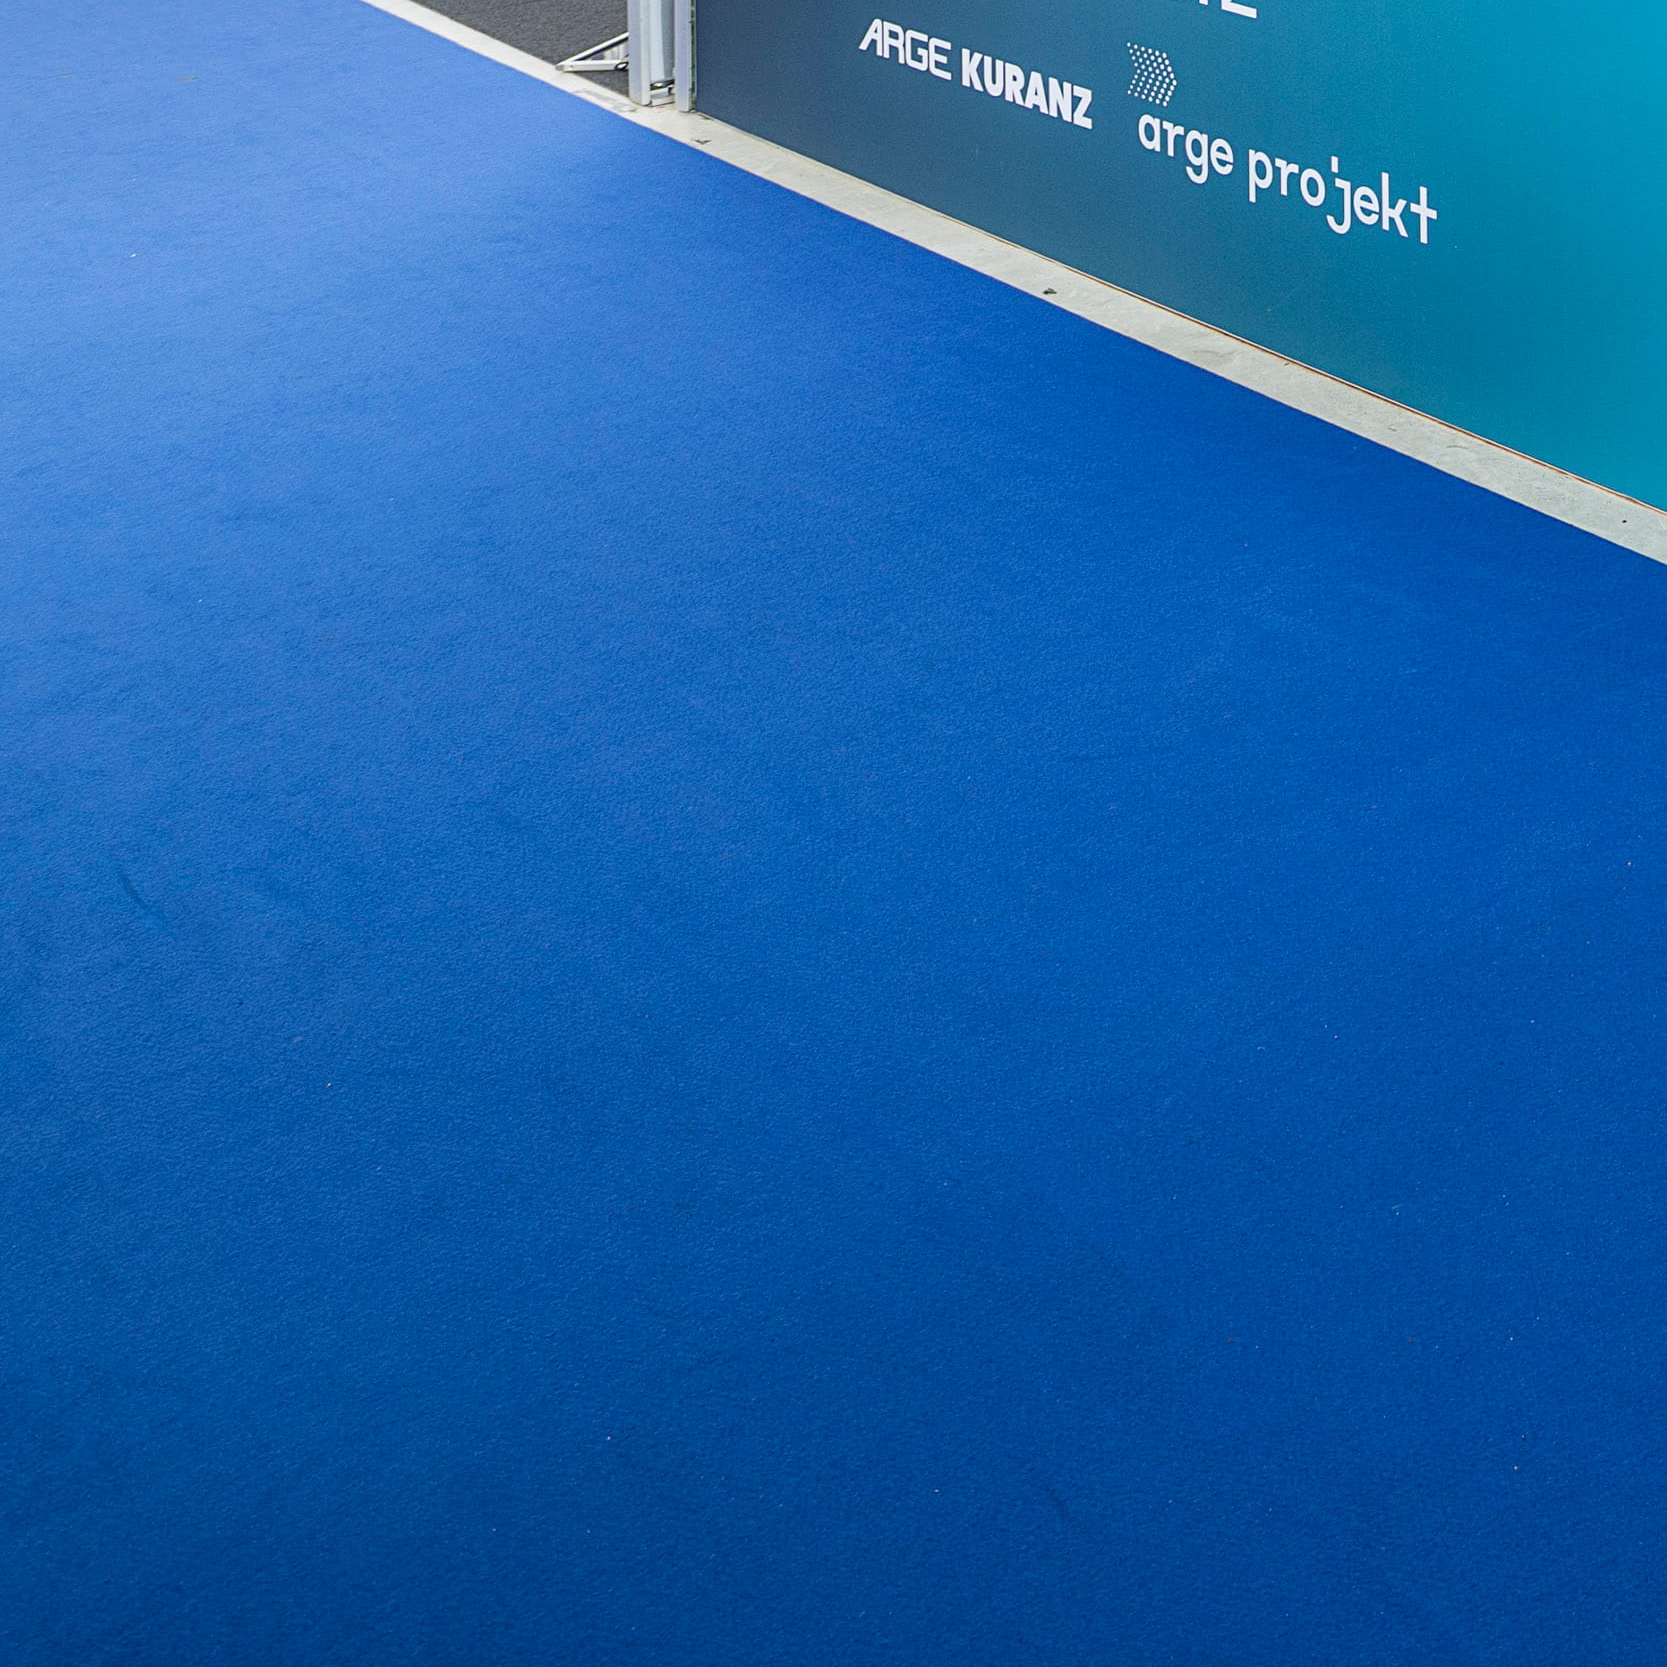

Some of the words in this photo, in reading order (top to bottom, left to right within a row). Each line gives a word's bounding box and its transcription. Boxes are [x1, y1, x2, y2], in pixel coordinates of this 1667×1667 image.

[858, 18, 952, 81] ARGE
[960, 47, 1093, 130] KURANZ
[1137, 113, 1234, 185] arge
[1247, 146, 1438, 245] projekt
